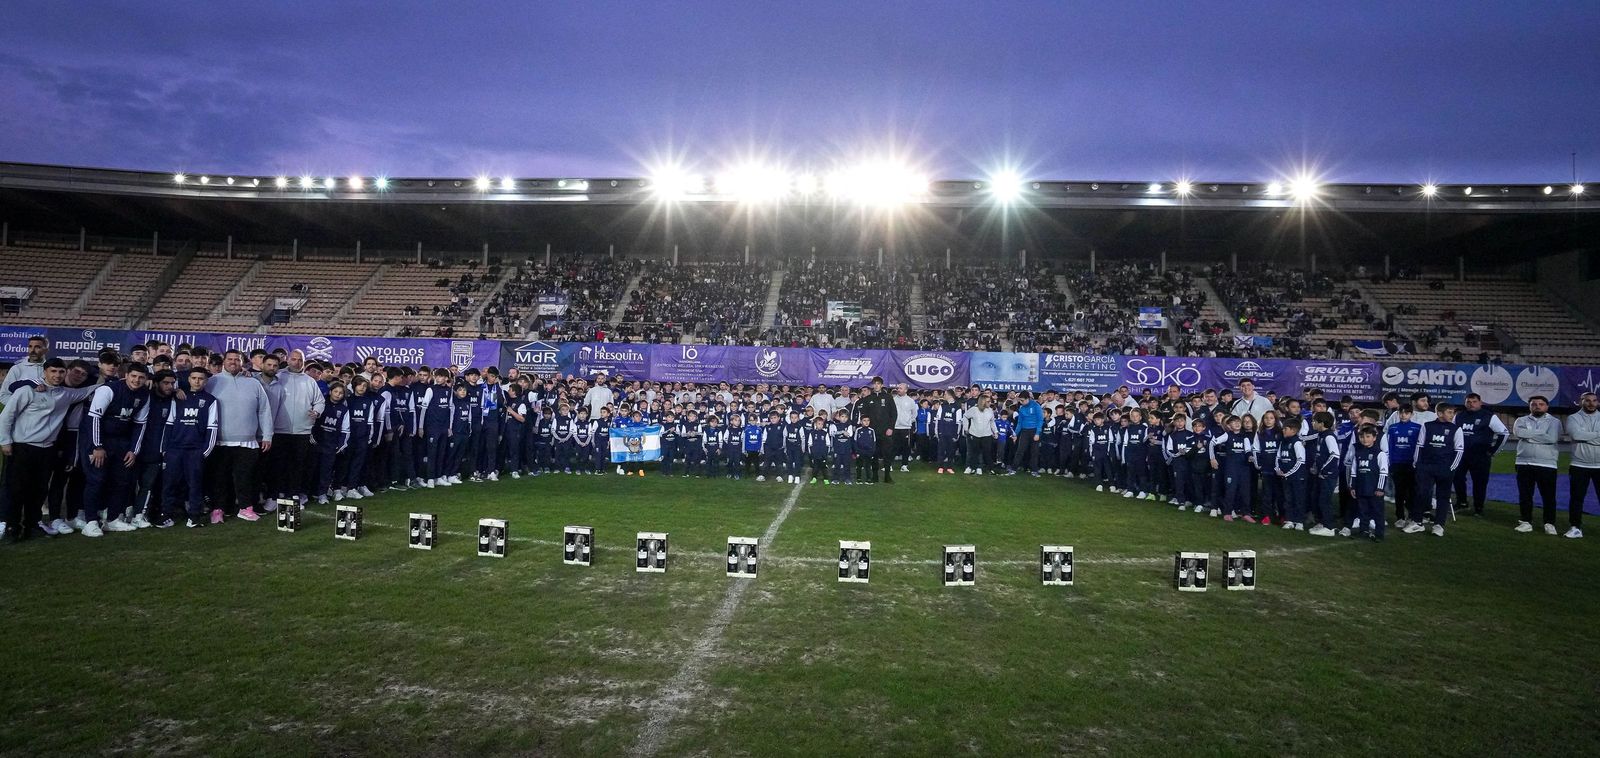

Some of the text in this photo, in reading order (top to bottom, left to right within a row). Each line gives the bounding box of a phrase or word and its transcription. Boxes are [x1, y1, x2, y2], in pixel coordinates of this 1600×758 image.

[55, 341, 120, 353] neopolises
[377, 347, 424, 356] TOLDOS
[594, 345, 606, 353] LA
[515, 351, 557, 363] MdR
[1053, 355, 1116, 363] CRISTOGARCÍA
[907, 364, 952, 376] LUGO
[1053, 362, 1116, 370] MARKETING
[1304, 366, 1363, 375] GRÚAS
[1304, 374, 1364, 383] SAN TELMO
[1407, 369, 1467, 386] SAKITO
[981, 383, 1033, 391] VALENTINA
